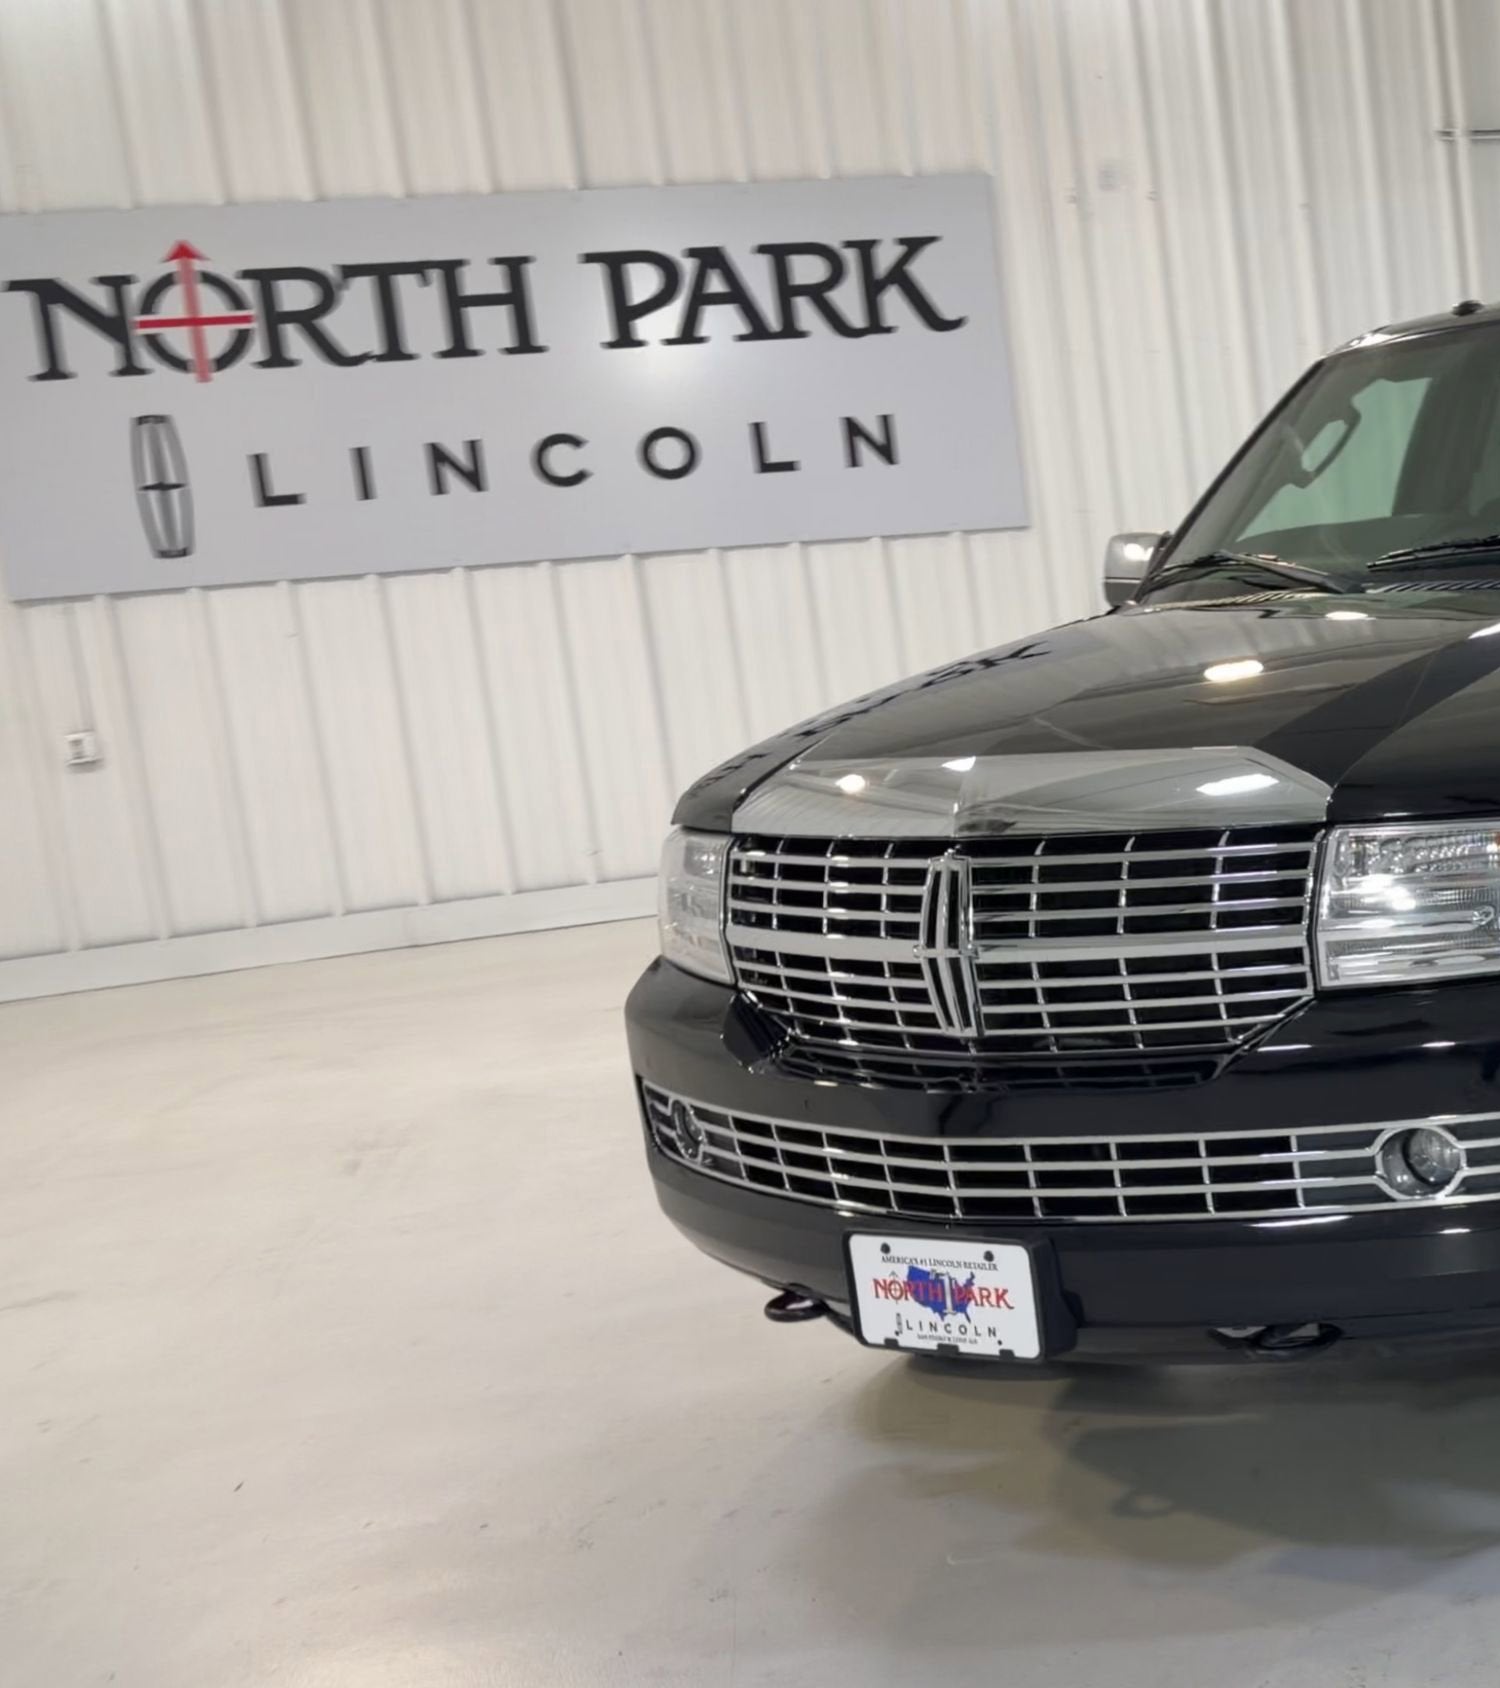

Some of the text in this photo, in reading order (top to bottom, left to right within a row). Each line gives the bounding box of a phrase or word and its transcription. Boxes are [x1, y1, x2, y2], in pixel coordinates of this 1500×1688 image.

[6, 235, 969, 382] NORTH PARK
[248, 413, 901, 508] LINCOLN
[928, 1258, 963, 1269] LINCOLN
[963, 1261, 999, 1272] RETAILER
[872, 1278, 1015, 1310] NORTH PARK
[906, 1319, 998, 1338] LINCOLN
